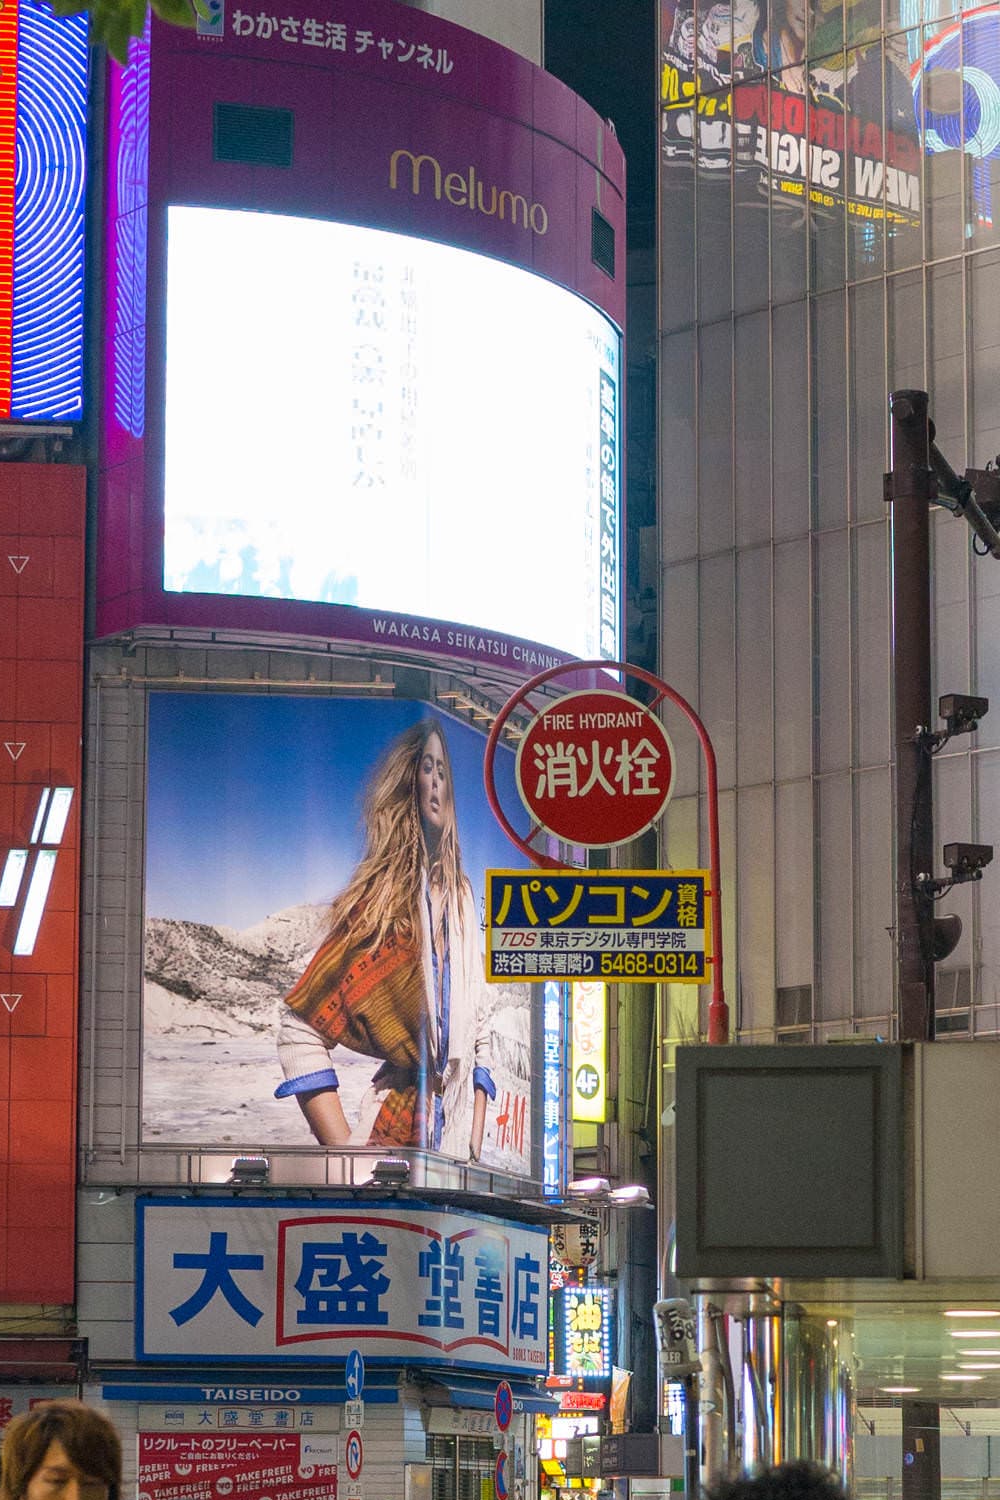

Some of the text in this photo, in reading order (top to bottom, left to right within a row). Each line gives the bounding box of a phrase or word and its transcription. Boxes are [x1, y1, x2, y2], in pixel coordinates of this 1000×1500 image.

[232, 9, 454, 74] わかさ生活 チャンネル
[372, 618, 442, 643] WAKASA
[447, 630, 508, 657] SEIKATSU
[543, 711, 645, 731] FIRE HYDRANT
[533, 738, 662, 800] 消火栓
[495, 880, 698, 928] パソコン 資格
[500, 932, 687, 948] TDS 東京デジタル専門学院
[494, 953, 698, 975] 渋谷警察署隣り 5468-0314
[575, 1068, 600, 1094] 4F
[169, 1231, 541, 1341] 大盛堂書店
[201, 1388, 301, 1401] TAISEIDO
[197, 1410, 314, 1427] 大盛堂書店
[143, 1438, 296, 1451] リクルートのフリーペーパー
[139, 1471, 171, 1484] PAPER
[235, 1468, 261, 1482] TAKE
[153, 1486, 179, 1498] TAKE
[236, 1481, 261, 1493] FREE
